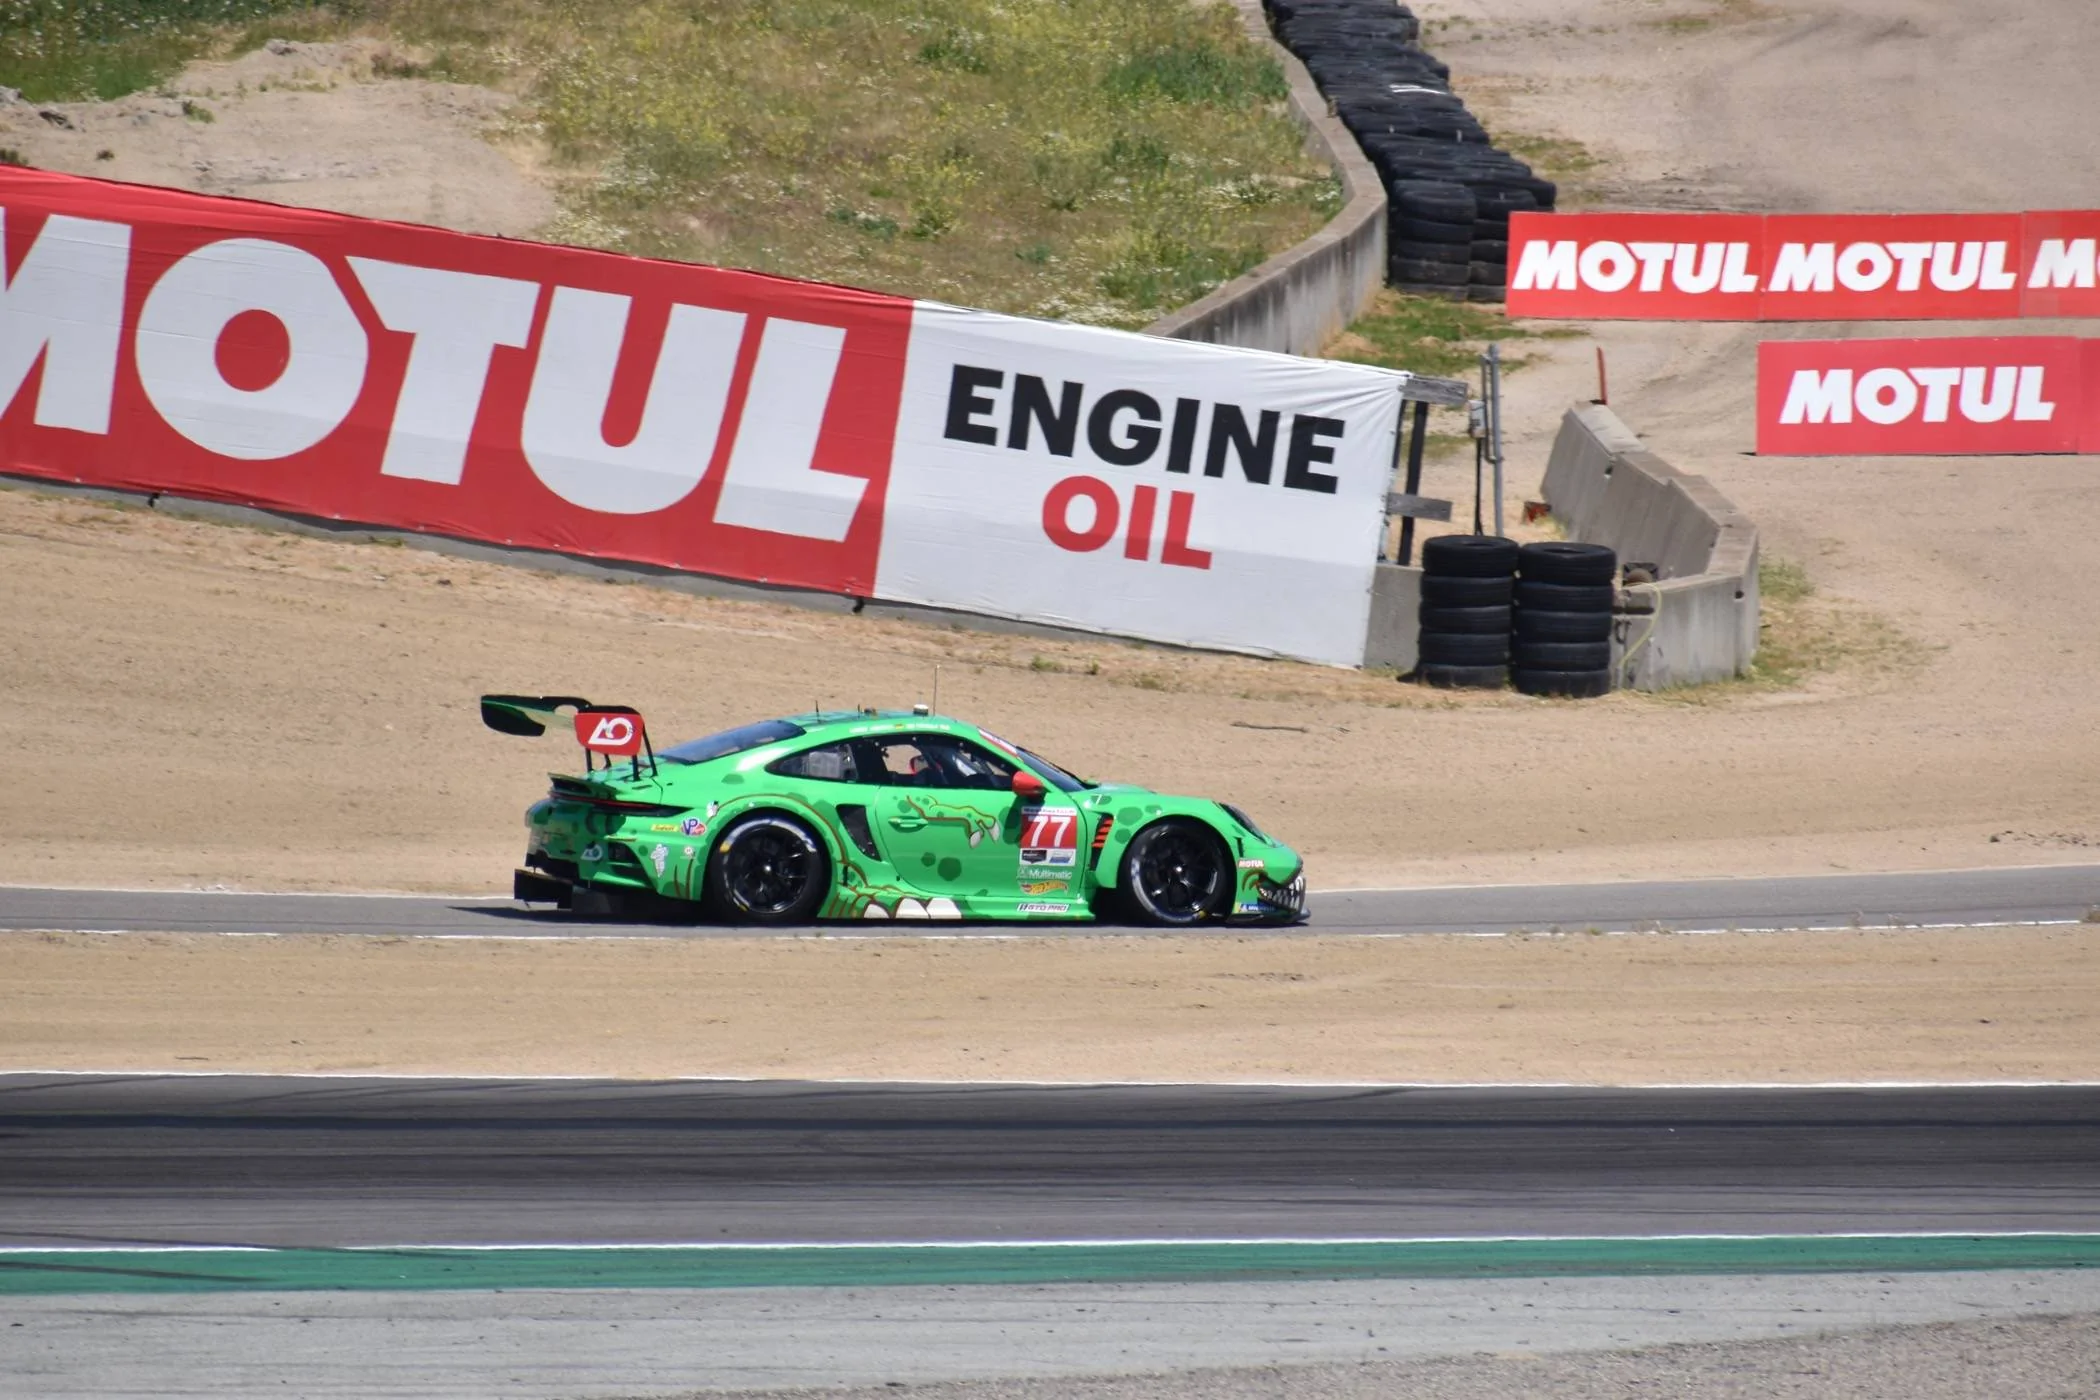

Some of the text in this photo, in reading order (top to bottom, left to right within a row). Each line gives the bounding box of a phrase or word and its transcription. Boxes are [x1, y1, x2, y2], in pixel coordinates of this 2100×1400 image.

[1512, 240, 1759, 294] MOTUL
[1768, 241, 2017, 292] MOTUL
[2027, 238, 2100, 289] M
[1779, 366, 2056, 424] MOTUL
[944, 365, 1344, 494] ENGINE
[1043, 476, 1211, 568] OIL
[1027, 815, 1072, 848] 77
